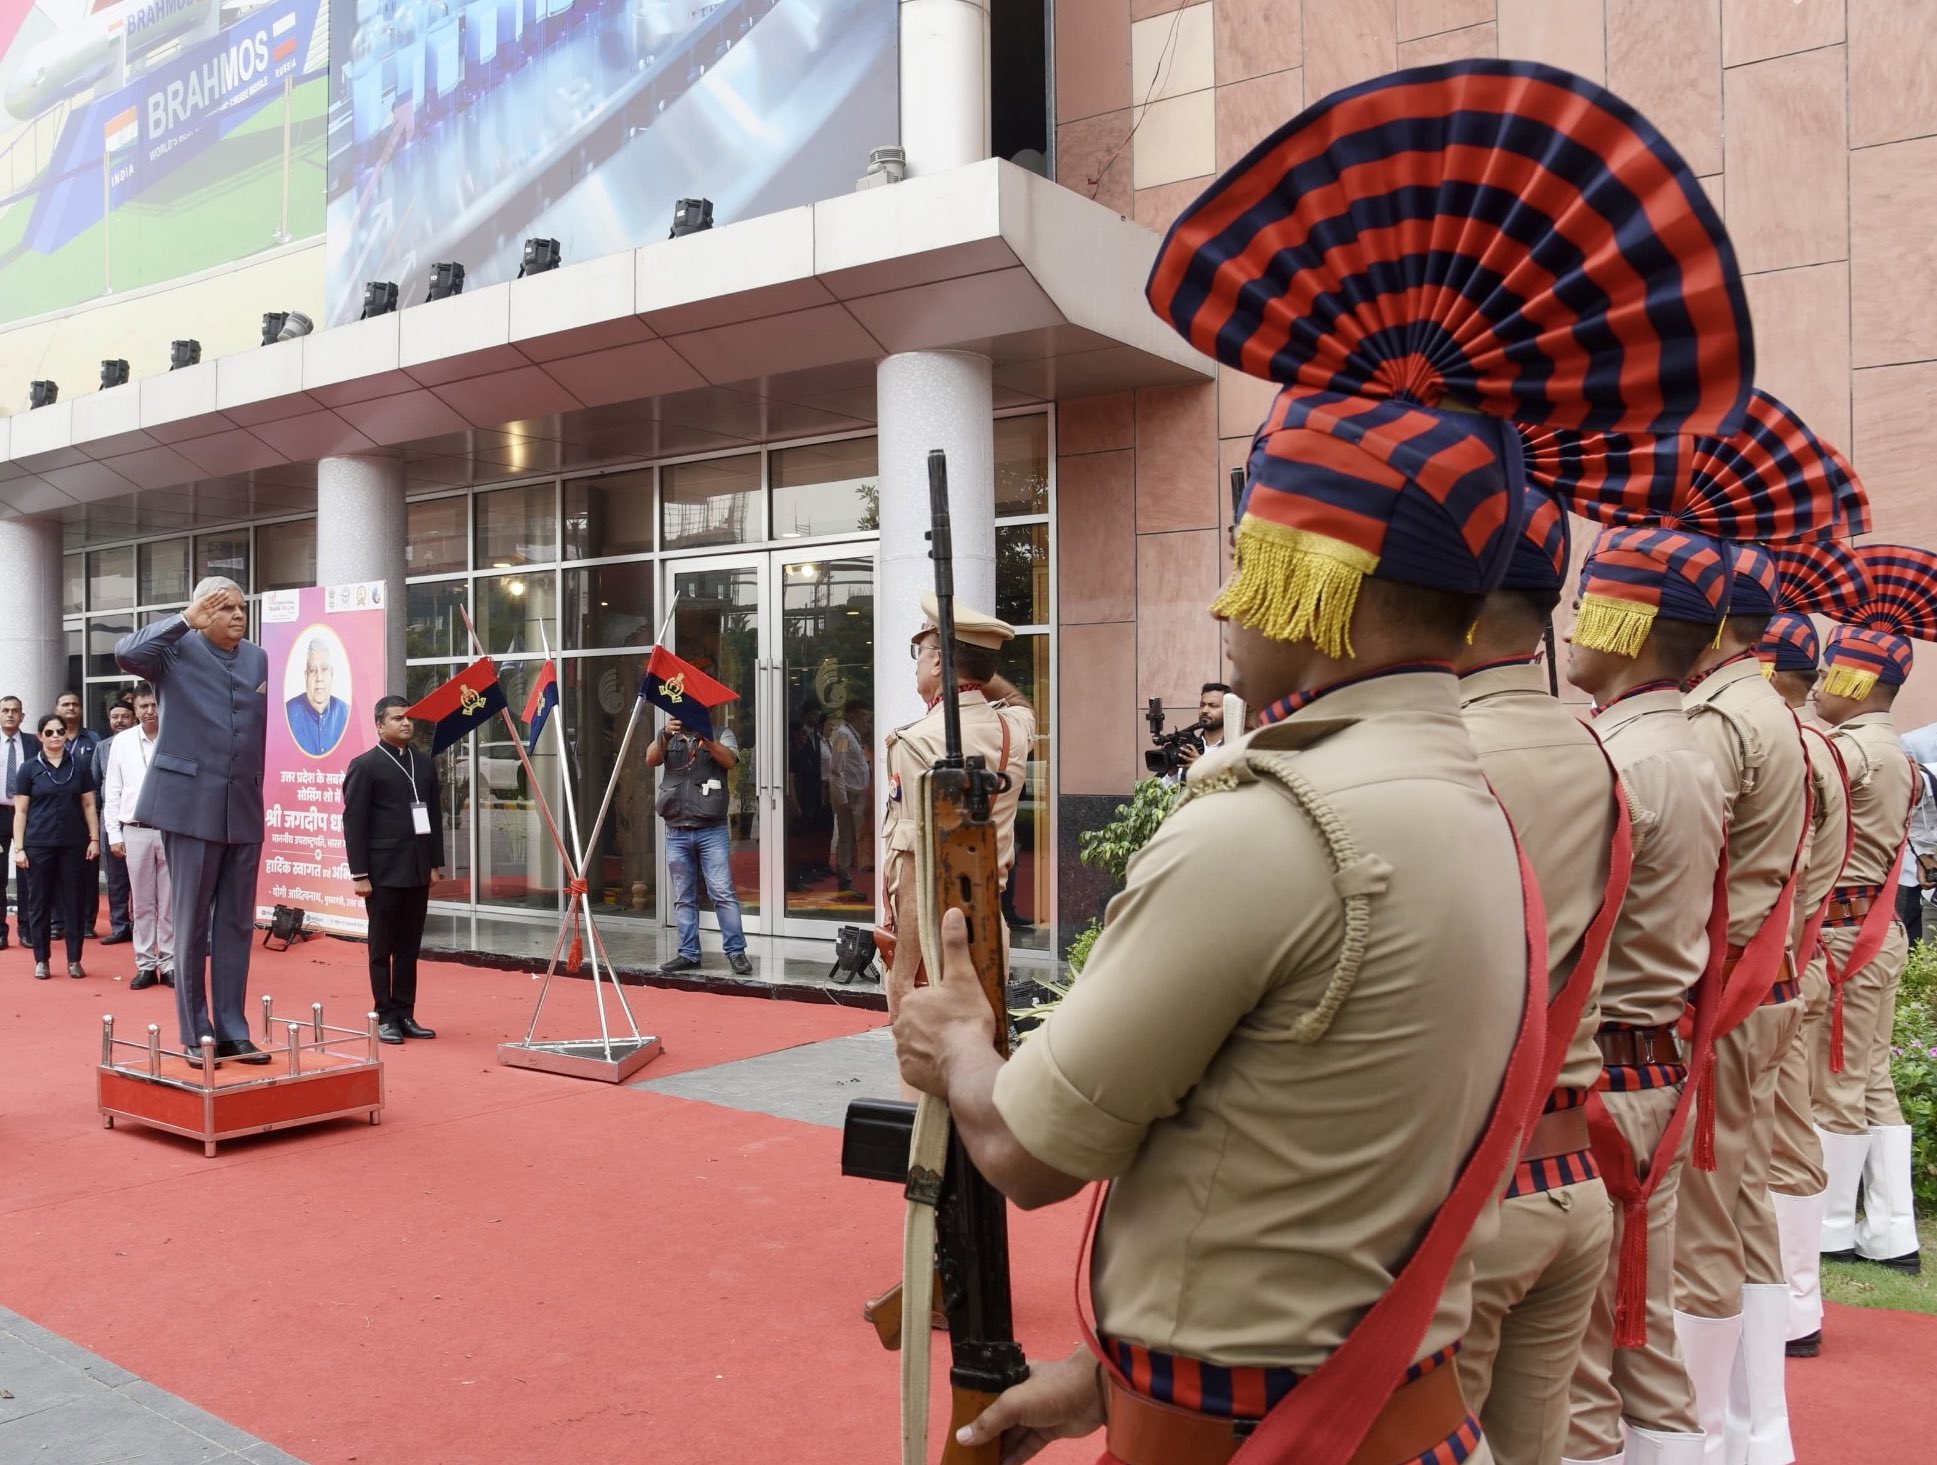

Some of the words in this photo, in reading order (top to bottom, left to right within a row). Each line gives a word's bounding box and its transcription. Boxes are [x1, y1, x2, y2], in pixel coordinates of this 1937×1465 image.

[275, 58, 296, 79] RUSSIA
[148, 30, 268, 140] BRAHMOS
[111, 164, 134, 188] INDIA
[280, 771, 296, 783] उत्तर
[297, 769, 315, 784] प्रदेश
[316, 769, 325, 783] के
[326, 769, 346, 785] सबसे
[323, 788, 333, 802] शो
[334, 788, 342, 804] में
[266, 804, 282, 827] श्री
[284, 806, 328, 832] जगदीप
[265, 856, 292, 874] हार्दिक
[293, 862, 321, 878] स्वागत
[272, 884, 287, 898] योगी
